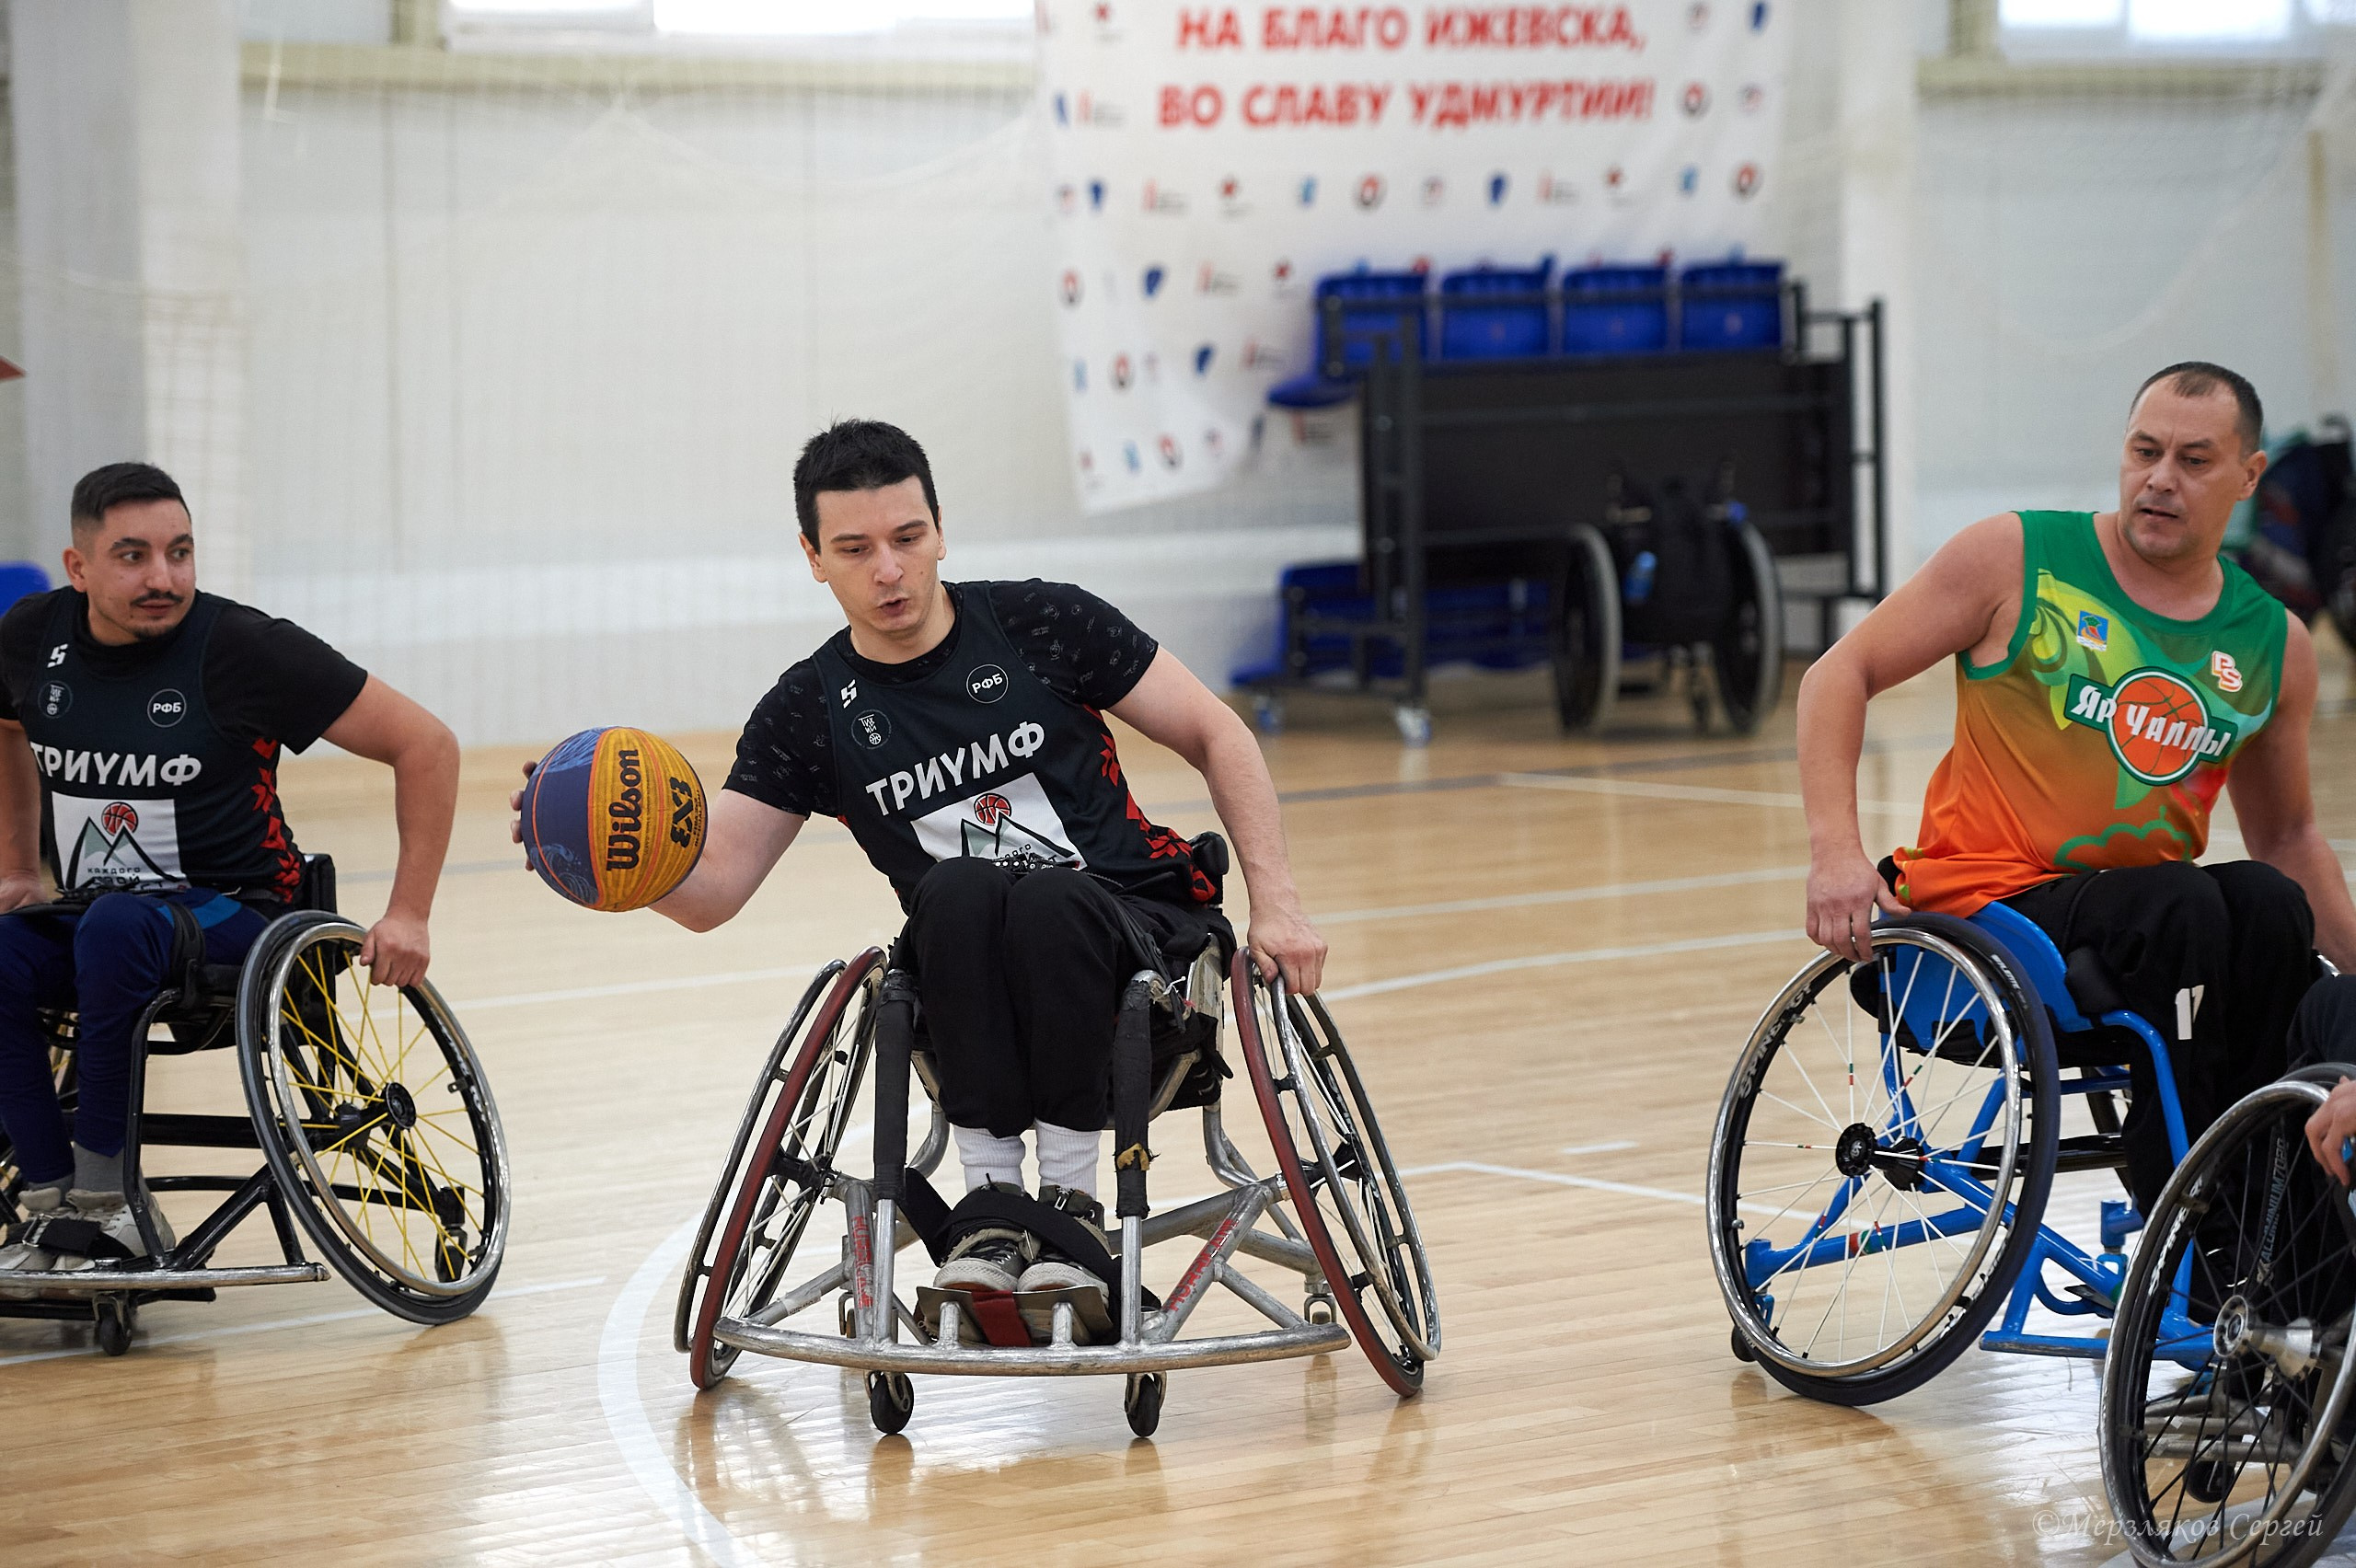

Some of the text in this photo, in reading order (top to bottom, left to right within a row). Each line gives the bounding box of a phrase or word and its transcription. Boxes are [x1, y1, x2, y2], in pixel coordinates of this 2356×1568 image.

[1176, 5, 1646, 52] НА БЛАГО ИЖЕВСКА,
[1157, 84, 1225, 128] ВО
[1242, 83, 1392, 128] СЛАВУ
[1410, 77, 1654, 130] УДМУРТИИ!
[971, 673, 1003, 694] РФБ
[152, 702, 181, 713] РФБ
[29, 741, 202, 787] ТРИУМФ
[865, 721, 1045, 816] ТРИУМФ
[606, 748, 642, 871] Wilson
